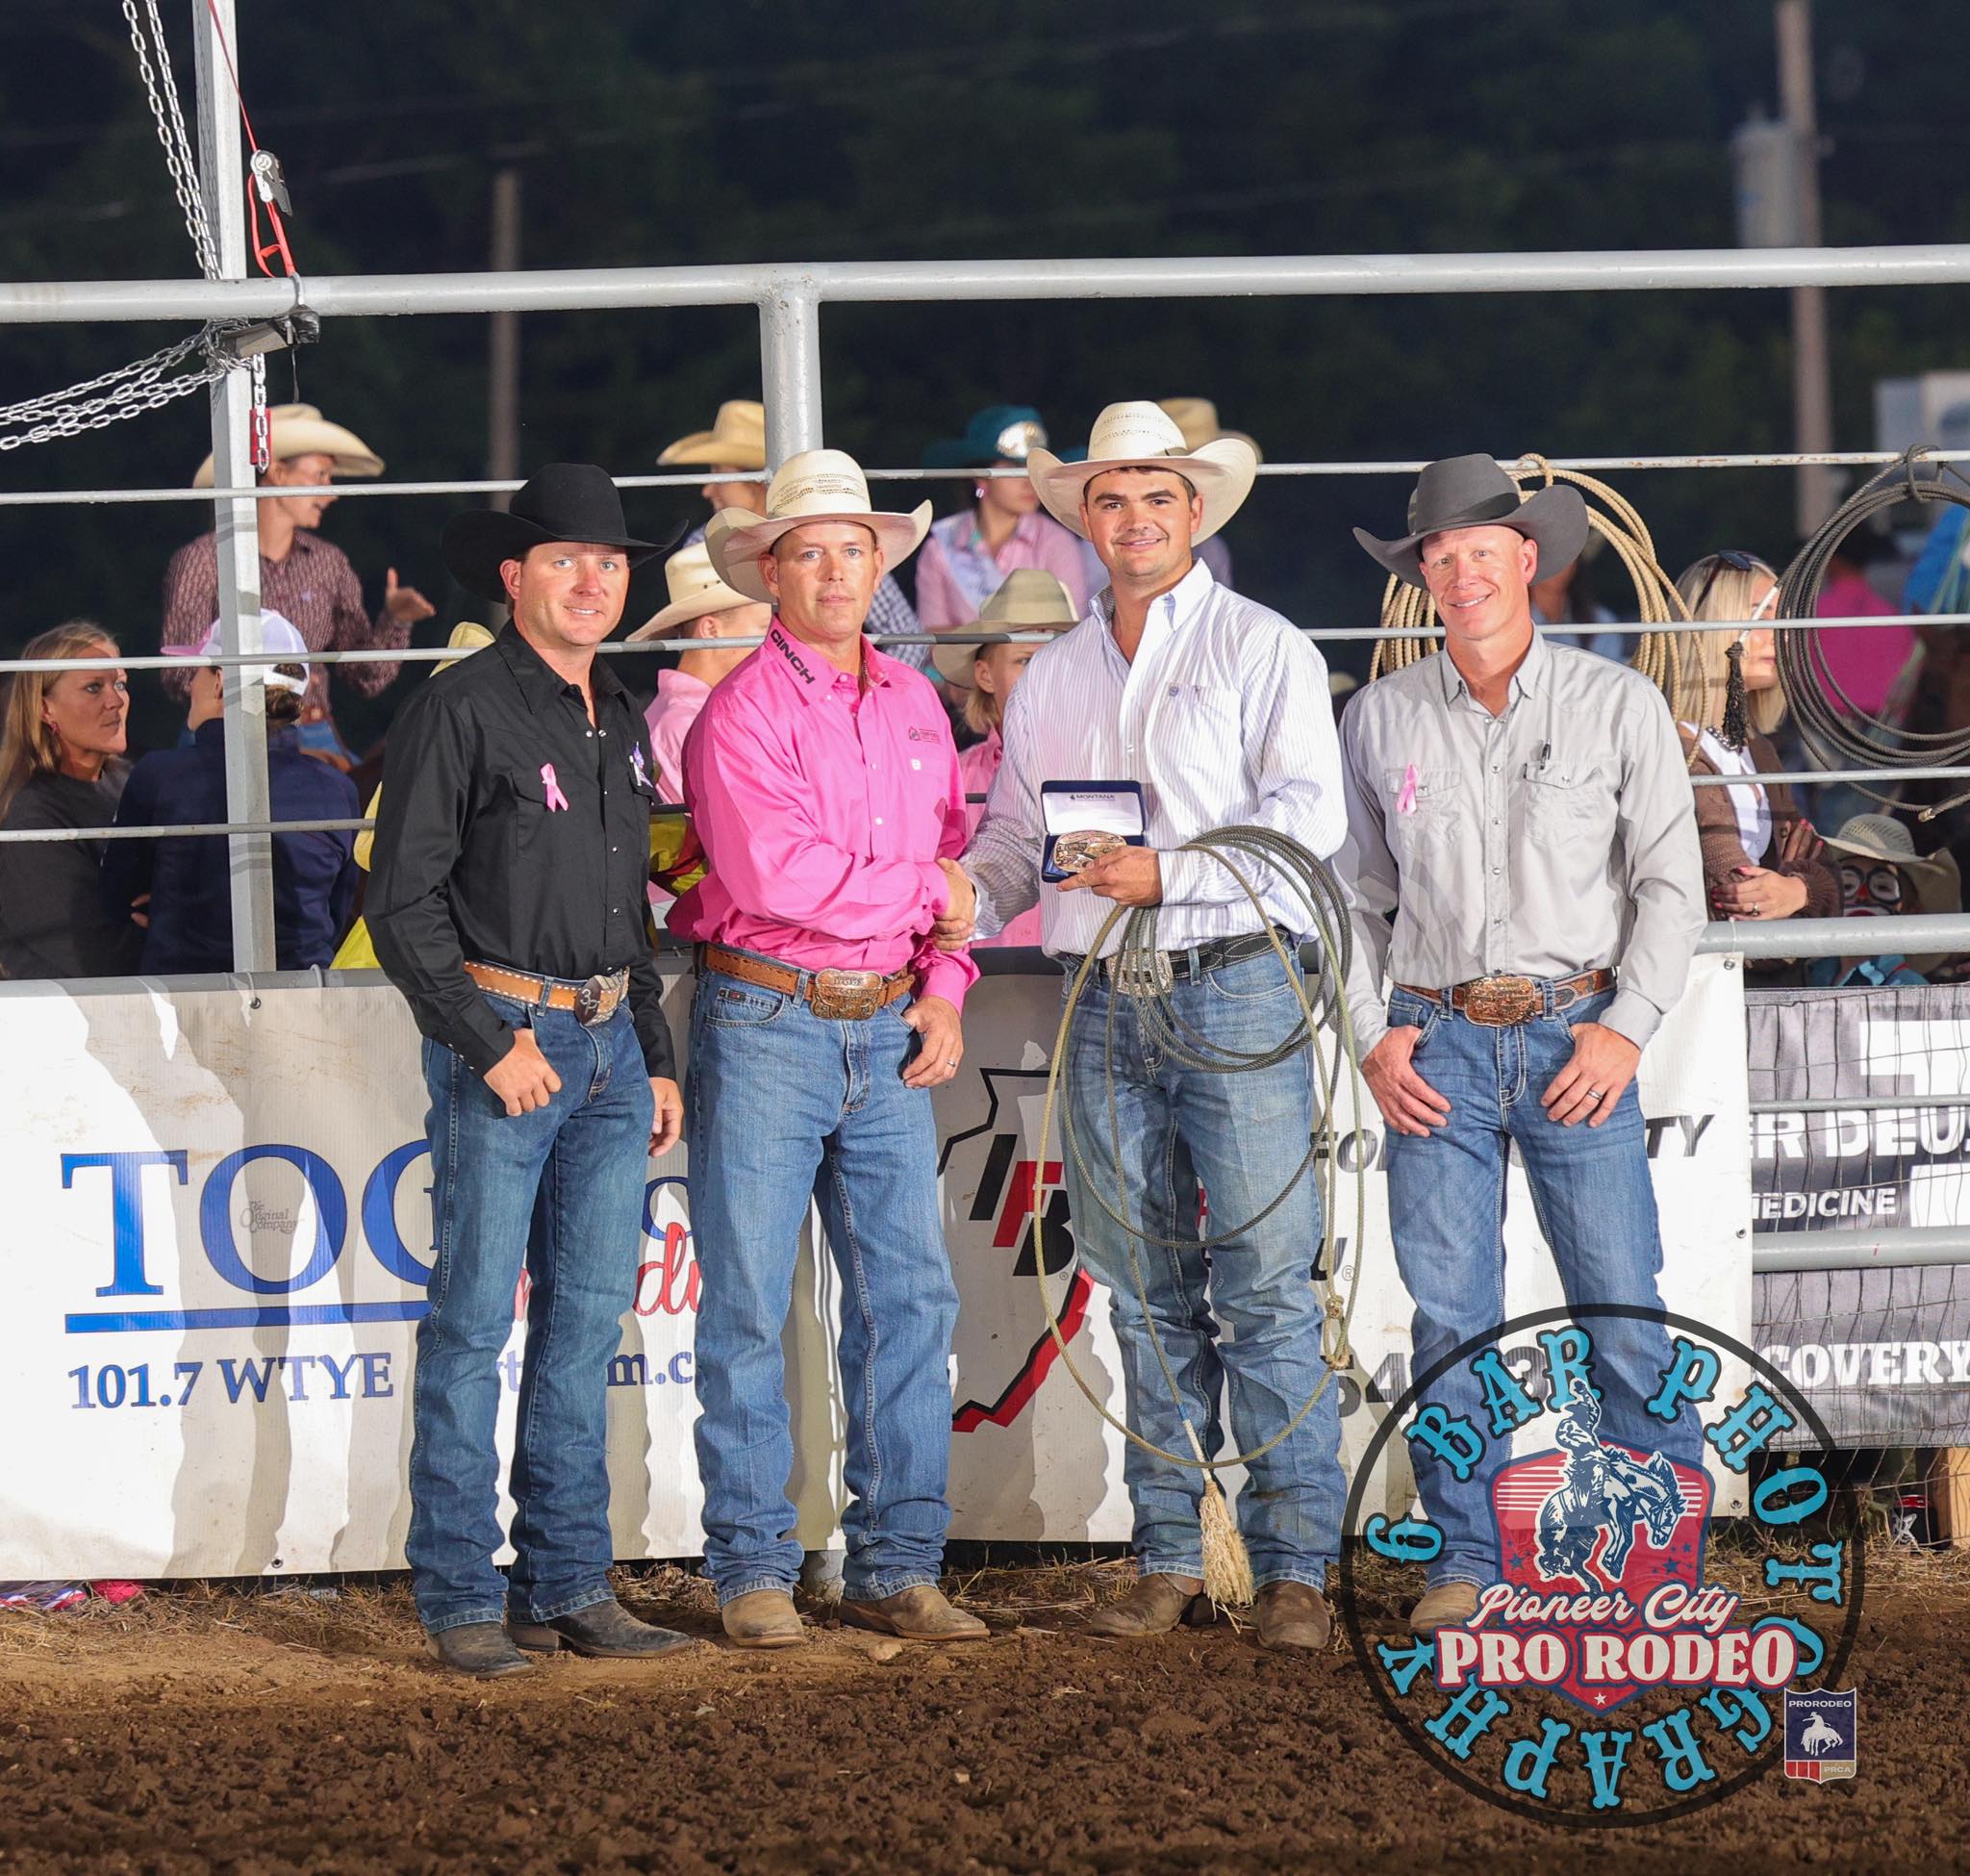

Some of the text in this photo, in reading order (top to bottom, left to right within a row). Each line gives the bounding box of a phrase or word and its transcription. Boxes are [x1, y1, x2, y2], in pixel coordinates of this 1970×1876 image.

[770, 629, 816, 684] CINCH
[240, 1208, 289, 1228] Original
[250, 1220, 294, 1234] Company
[68, 1353, 393, 1408] 101.7 WTYE
